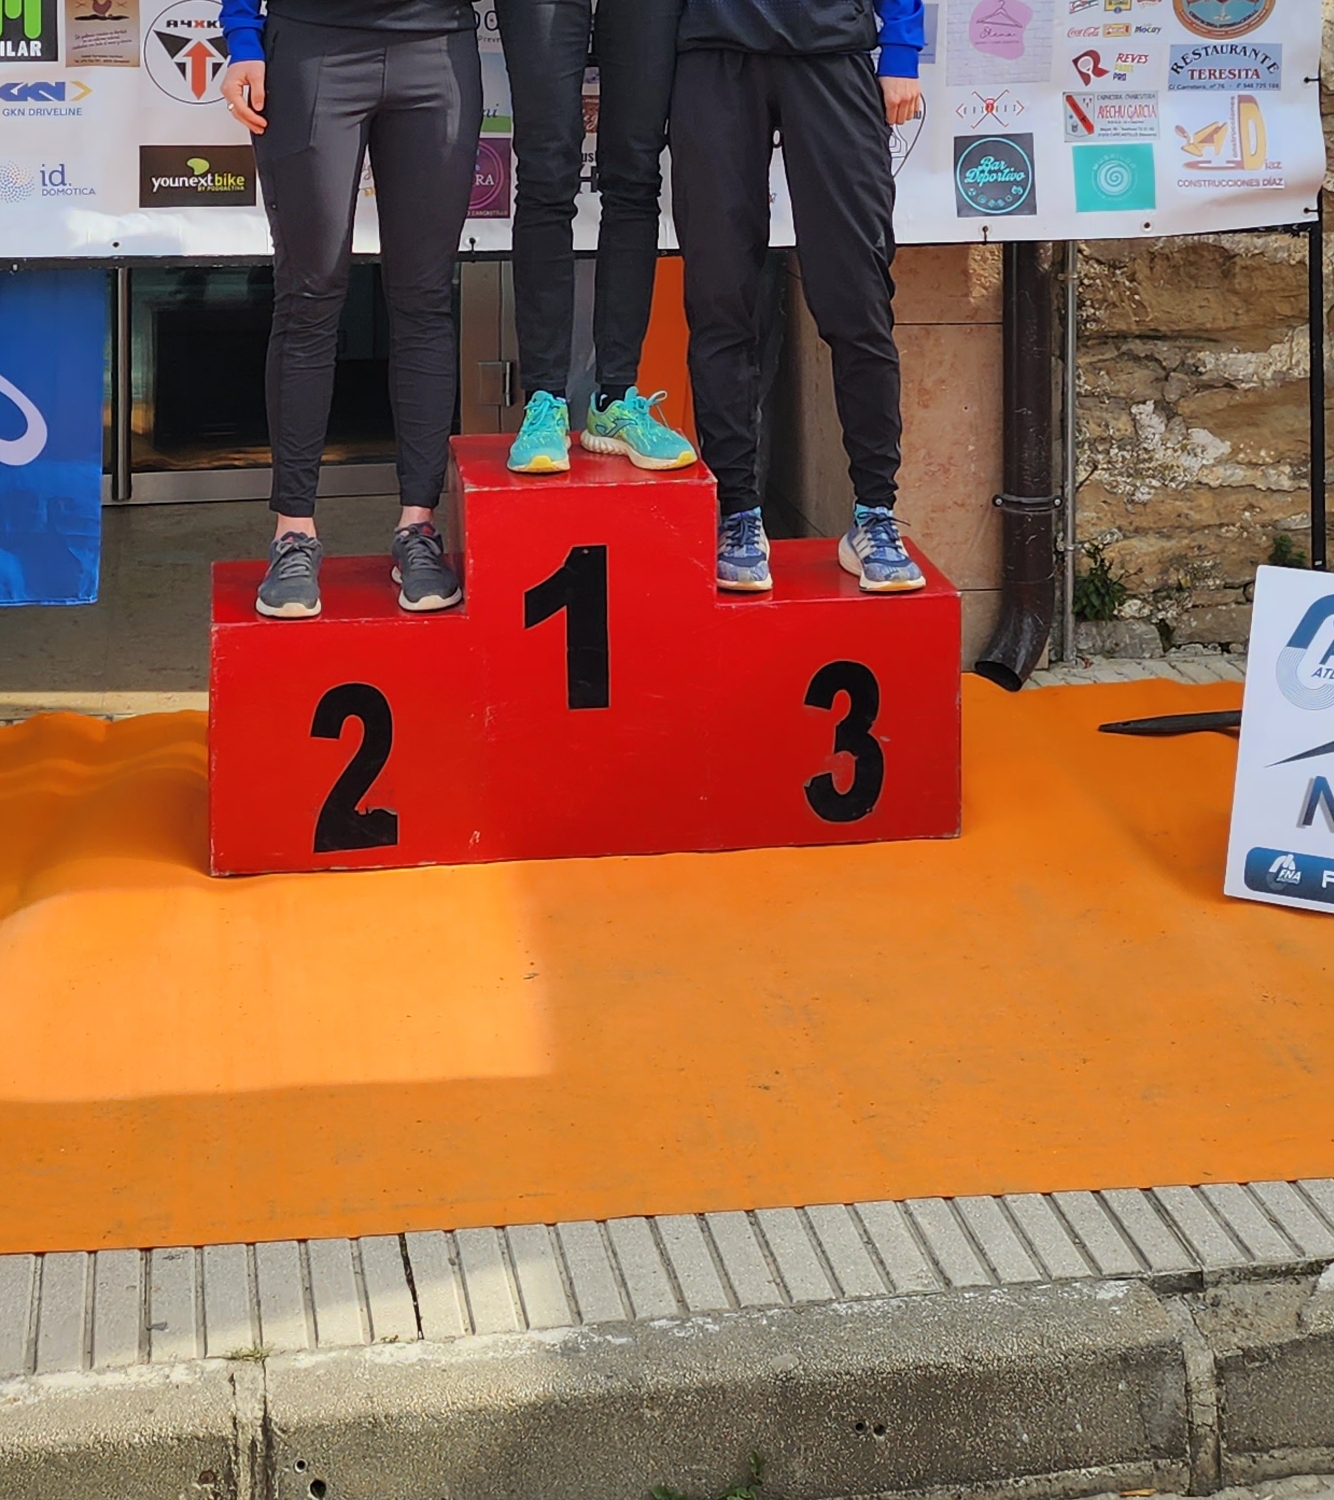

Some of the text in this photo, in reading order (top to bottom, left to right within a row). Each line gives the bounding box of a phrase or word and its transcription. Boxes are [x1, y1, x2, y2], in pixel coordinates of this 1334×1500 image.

[1170, 44, 1280, 75] RESTAURANTE
[1187, 68, 1261, 80] TERESITA
[2, 107, 83, 117] GKN DRIVELINE
[978, 155, 1007, 171] Bar
[151, 172, 246, 192] younextbike
[964, 167, 1026, 187] Deportivo
[1177, 179, 1261, 188] CONSTRUCCIONES
[524, 544, 610, 710] 1
[803, 660, 885, 823] 3
[310, 682, 398, 854] 2
[1278, 868, 1302, 883] FNA
